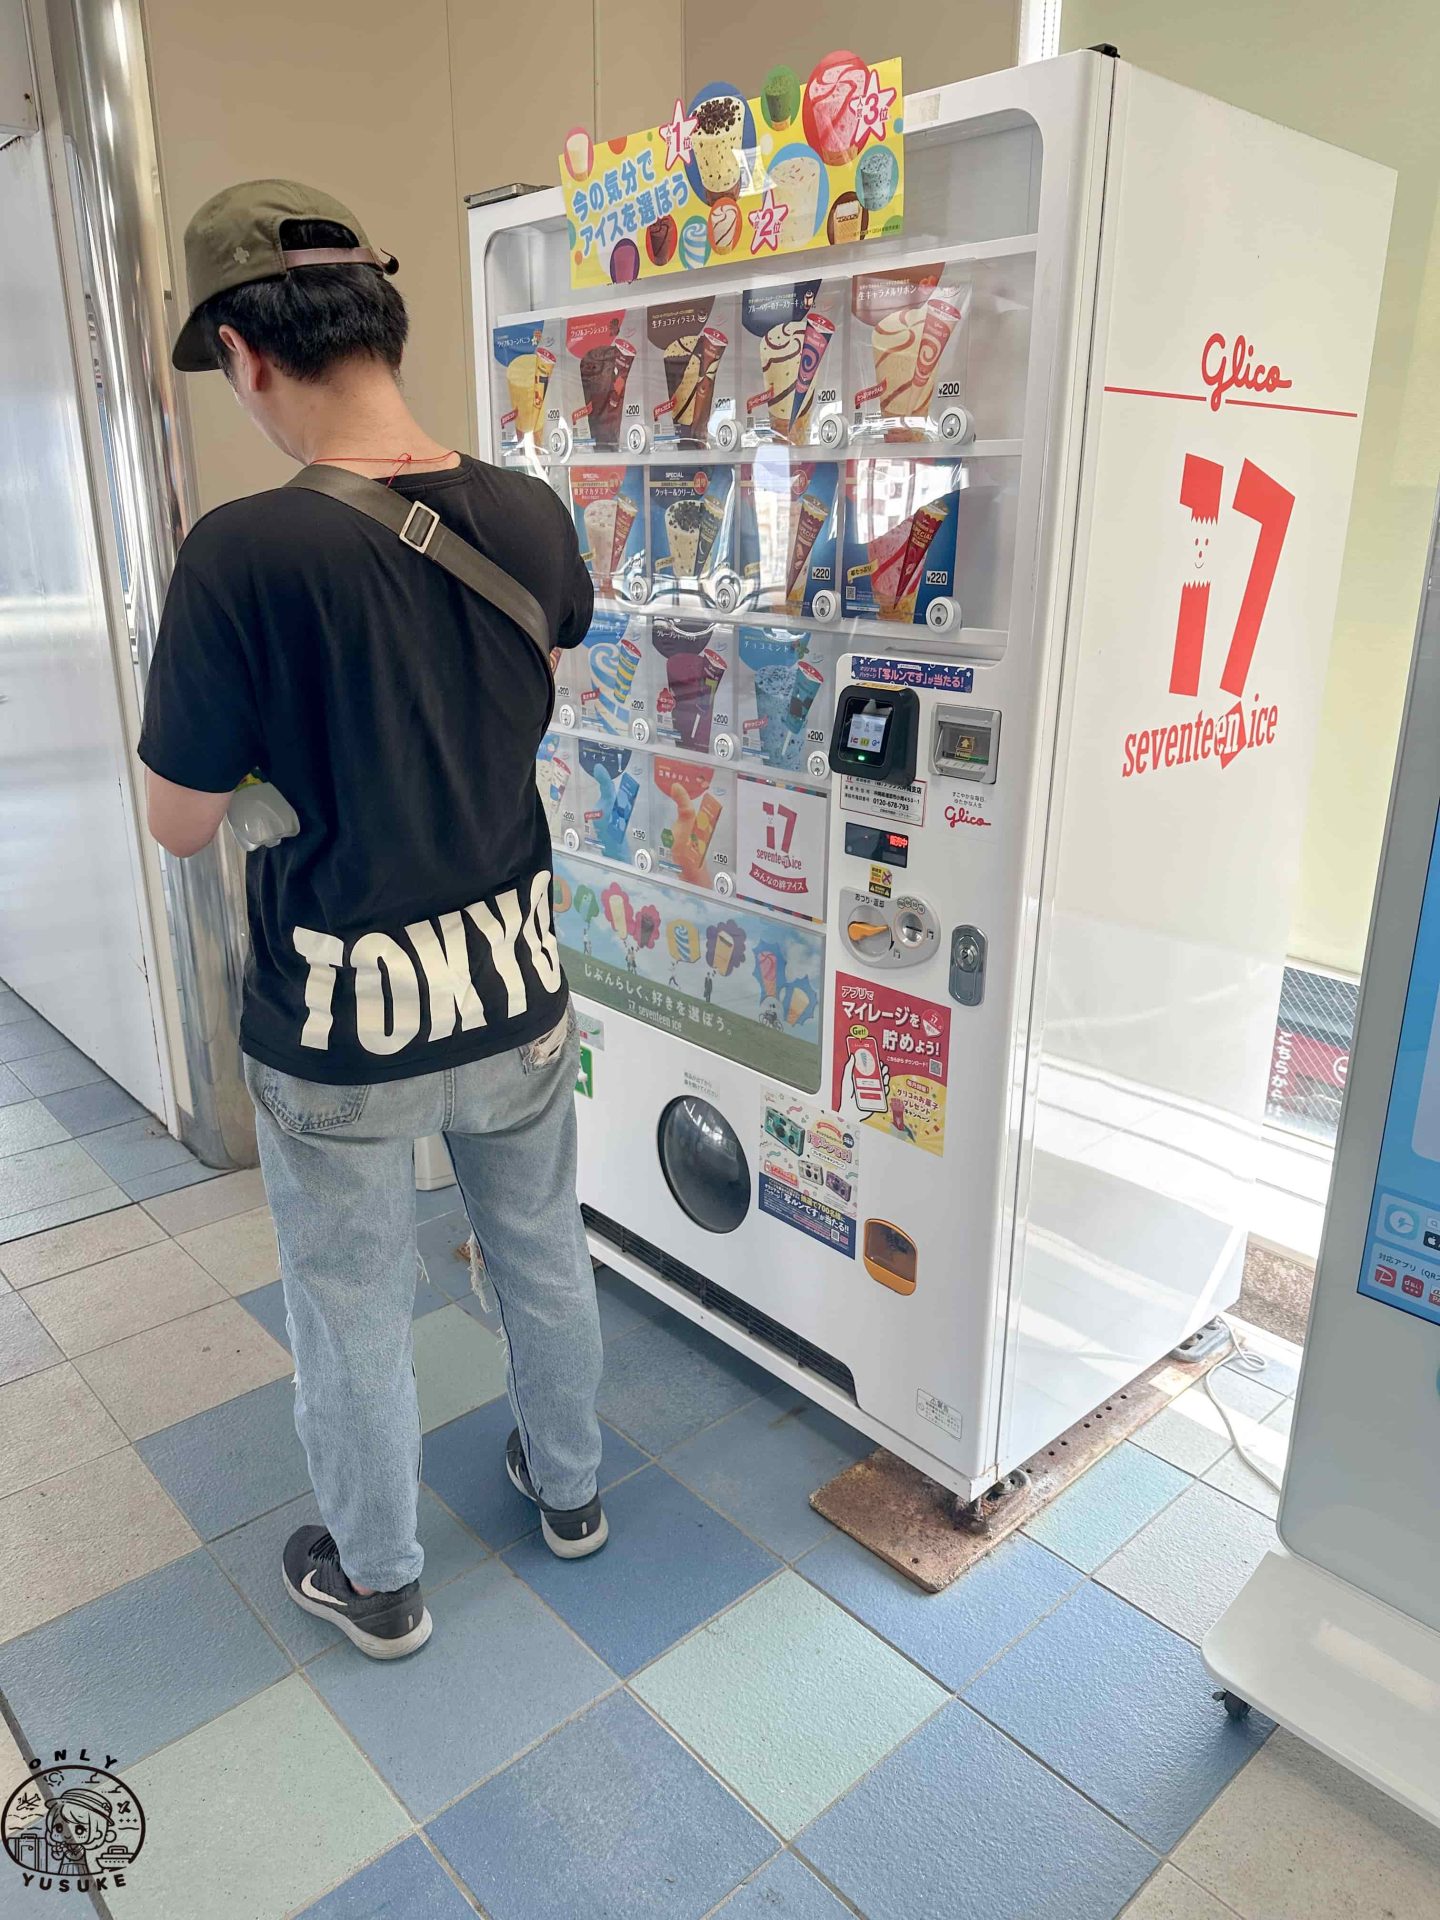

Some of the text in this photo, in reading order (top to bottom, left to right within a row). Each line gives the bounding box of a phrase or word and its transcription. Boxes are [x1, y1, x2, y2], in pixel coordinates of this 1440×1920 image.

[572, 149, 655, 223] 今の気分で
[579, 173, 689, 257] アイスを選ぼう
[1201, 332, 1292, 412] Glico
[938, 383, 959, 395] ¥200
[813, 568, 830, 579] ¥220
[927, 572, 947, 583] ¥220
[1121, 693, 1279, 778] seventeen ice
[944, 806, 991, 828] Glico
[792, 856, 802, 870] ice
[292, 869, 562, 1056] TOKYO
[584, 962, 732, 1037] じぶんらしく、好きを選ぼう。
[841, 986, 874, 1000] アプリで
[638, 1005, 671, 1028] seventeen
[671, 1016, 682, 1032] ice
[841, 1000, 921, 1029] マイレージを
[852, 1026, 866, 1036] Get!
[882, 1029, 941, 1056] 貯めよう!
